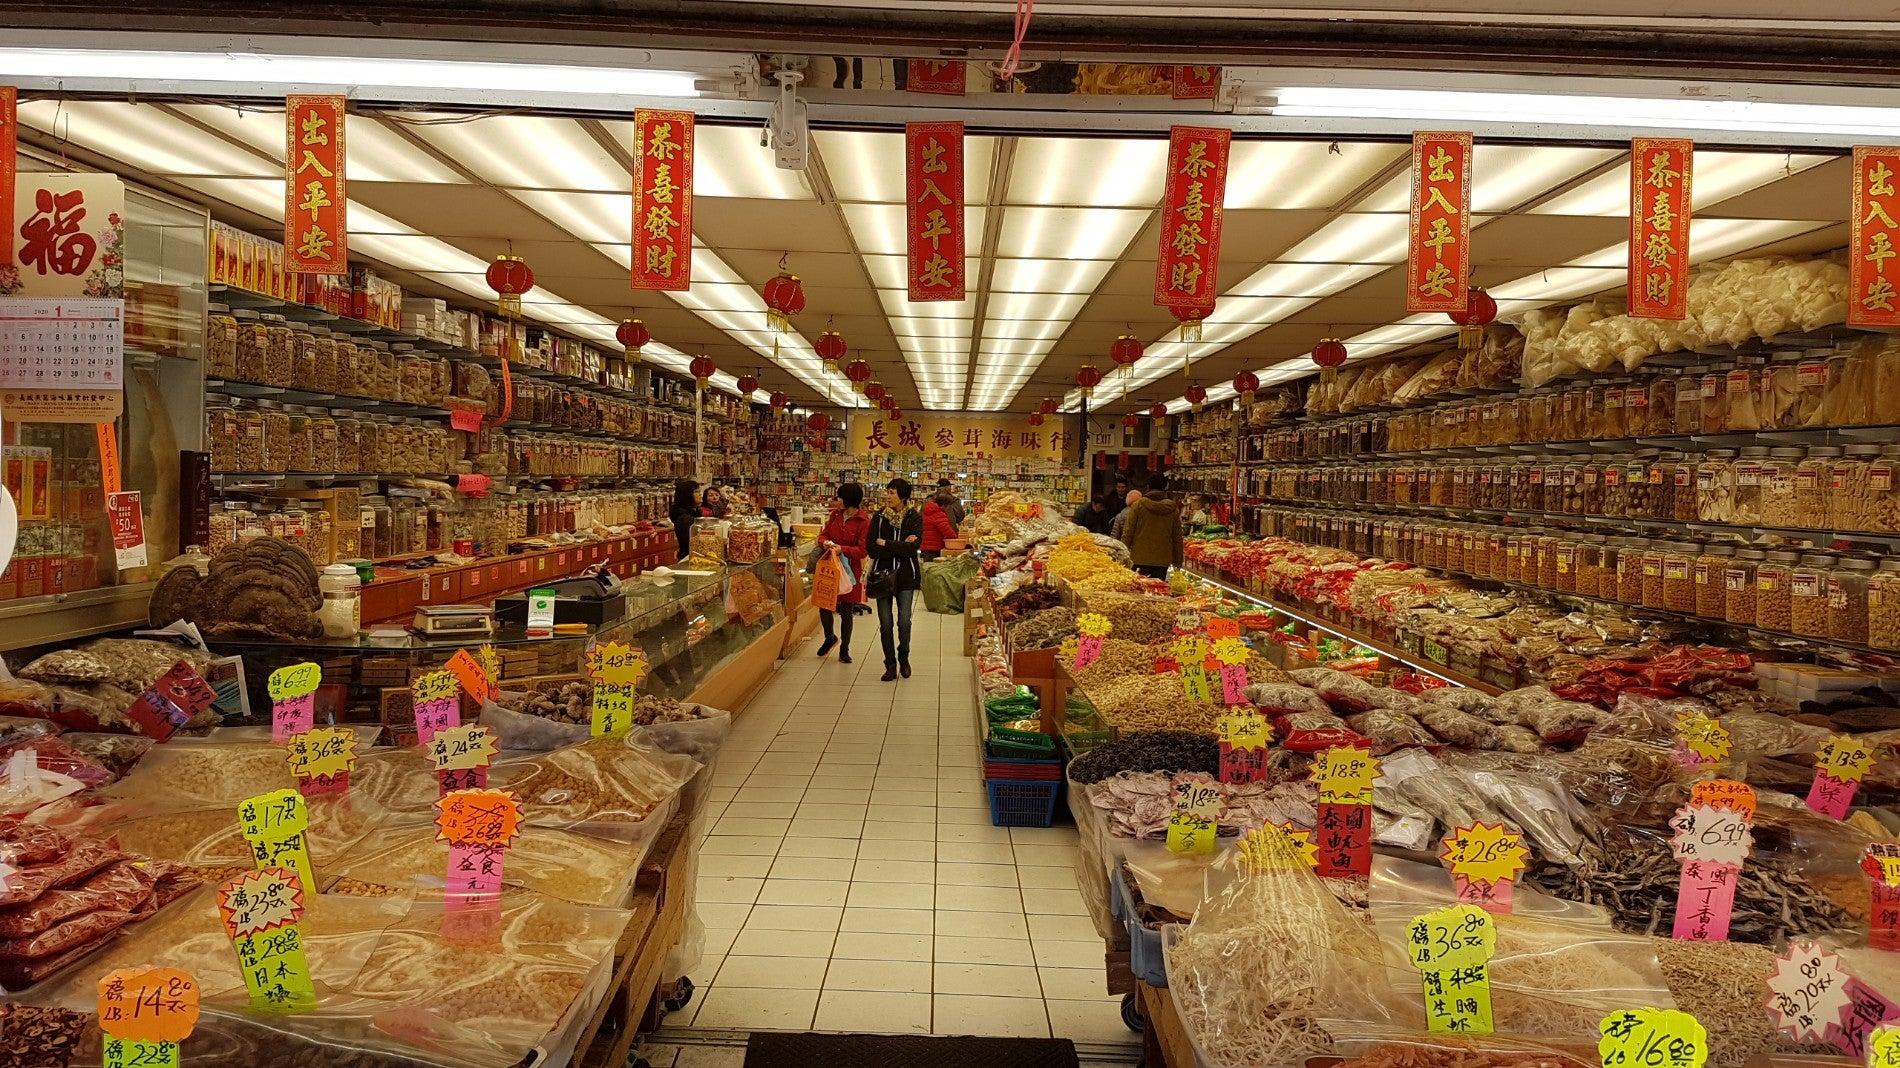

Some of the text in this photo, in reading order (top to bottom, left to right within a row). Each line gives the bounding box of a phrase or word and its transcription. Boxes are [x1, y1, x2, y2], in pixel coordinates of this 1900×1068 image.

[18, 188, 97, 276] 福
[297, 109, 334, 261] 出入平安
[643, 122, 682, 278] 恭喜發財
[917, 136, 954, 289] 出入平安
[1169, 140, 1217, 295] 恭喜發財
[1418, 145, 1459, 298] 出入平安
[1643, 151, 1681, 306] 恭喜發財
[1862, 161, 1899, 312] 出入平安
[55, 305, 61, 317] 1
[1096, 433, 1112, 445] EXIT
